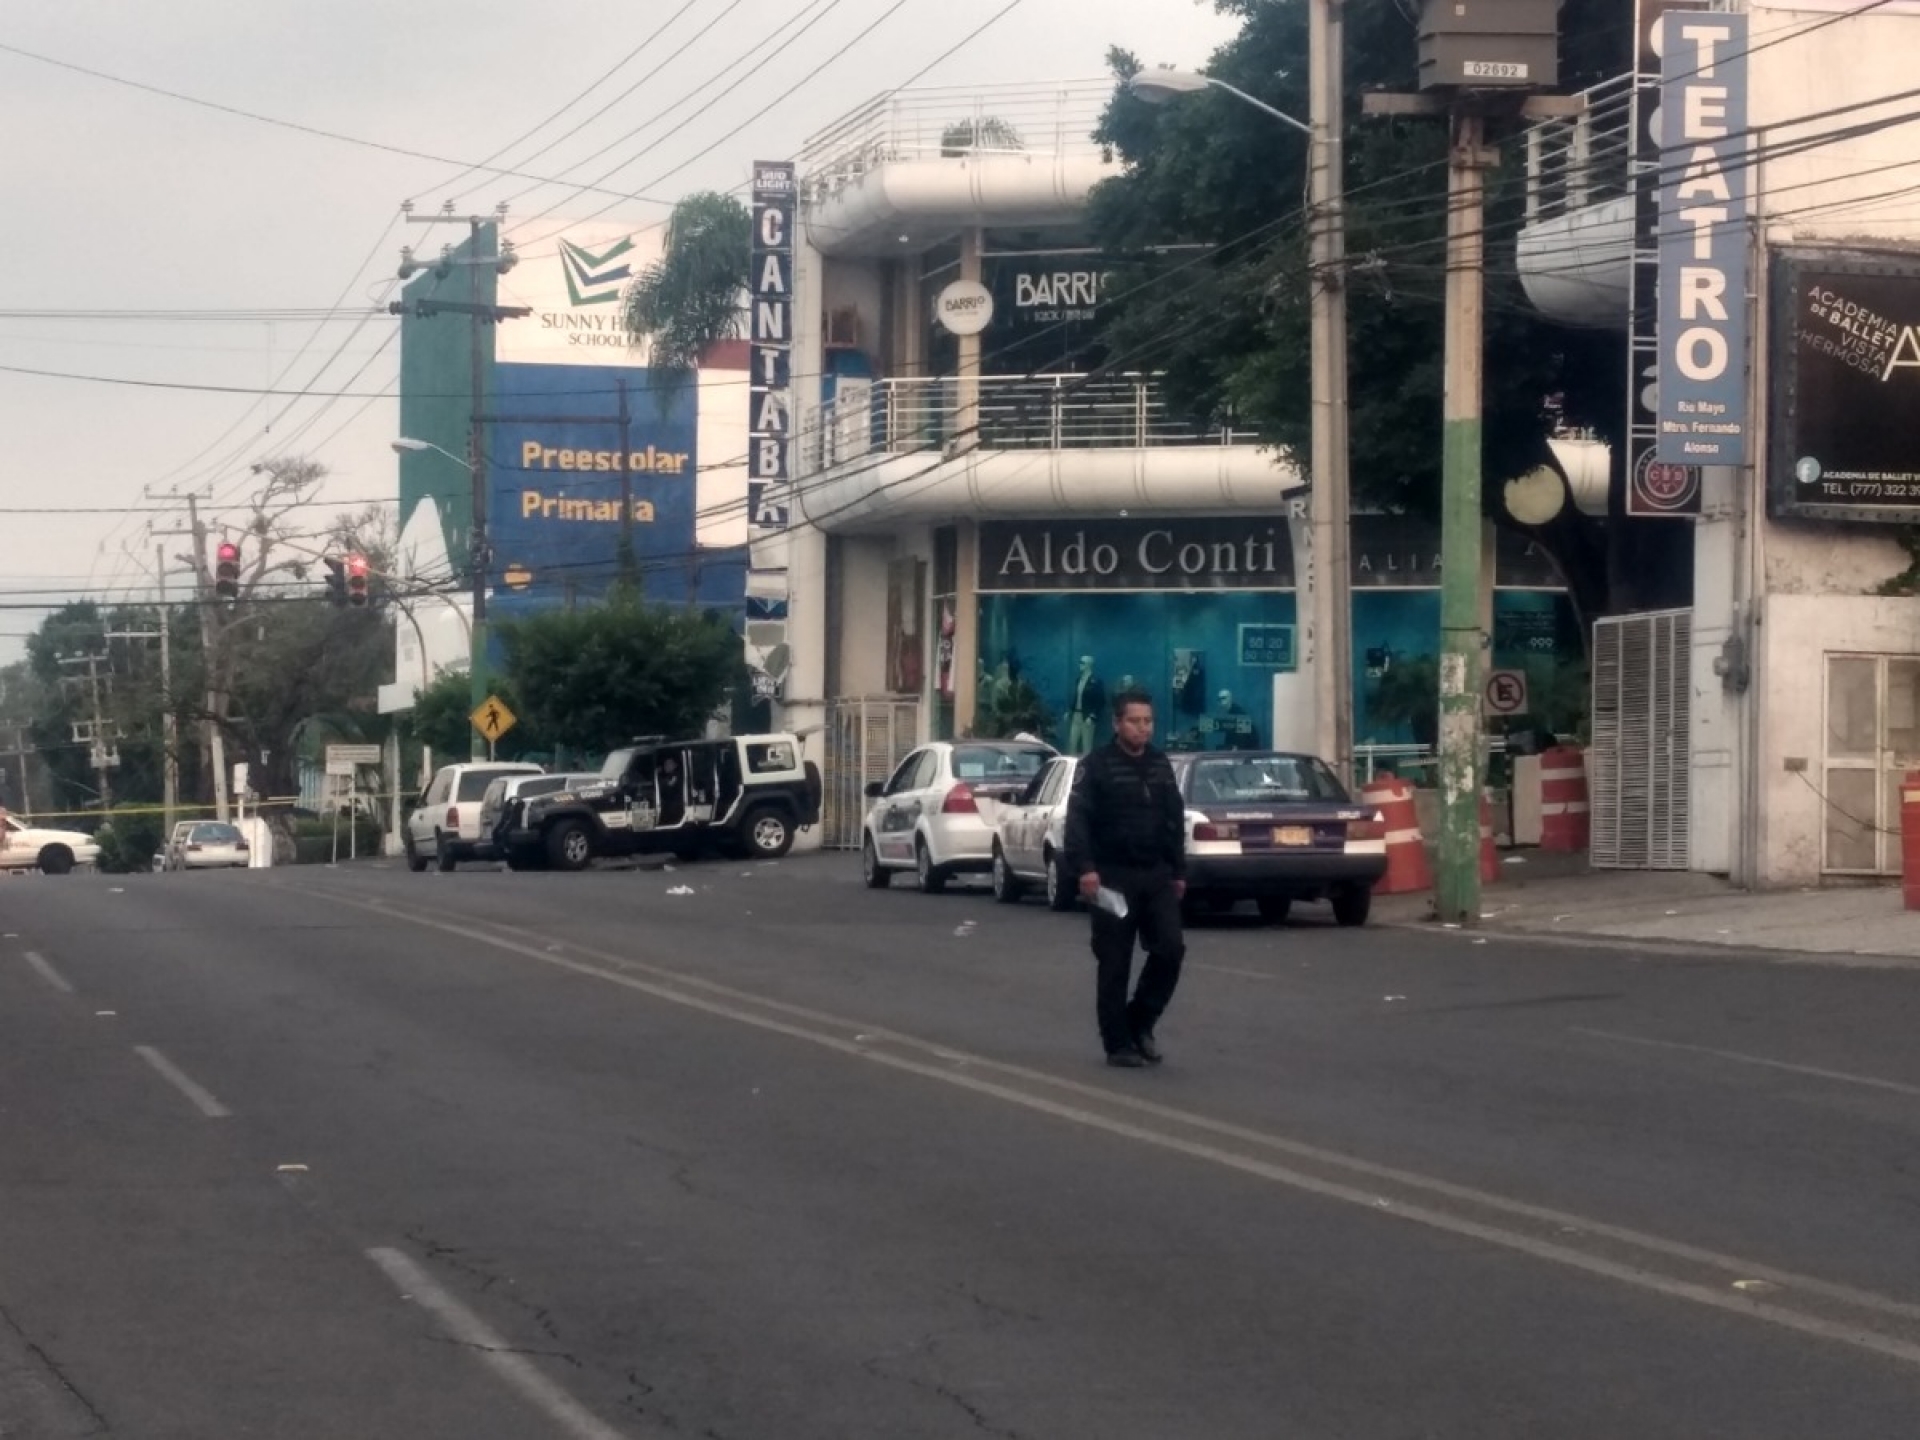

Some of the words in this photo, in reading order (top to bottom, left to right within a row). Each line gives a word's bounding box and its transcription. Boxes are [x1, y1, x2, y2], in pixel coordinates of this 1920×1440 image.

[1473, 63, 1518, 76] 02692
[1675, 26, 1731, 382] TEATRO
[945, 295, 985, 312] BARRIO
[1808, 286, 1897, 336] ACADEMIA
[541, 313, 606, 331] SUNNY
[1810, 303, 1827, 317] DE
[1829, 312, 1895, 347] BALLET
[1800, 331, 1880, 377] HERMOSA
[1842, 332, 1885, 364] VISTA
[1698, 401, 1726, 416] Mayo
[1692, 421, 1741, 434] Fernando
[522, 441, 689, 474] Preescolar
[1851, 483, 1882, 496] (777)
[1884, 484, 1906, 496] 322
[1882, 472, 1912, 481] BALLET
[522, 490, 654, 522] Primaria
[999, 531, 1119, 575] Aldo
[1138, 528, 1276, 574] Conti
